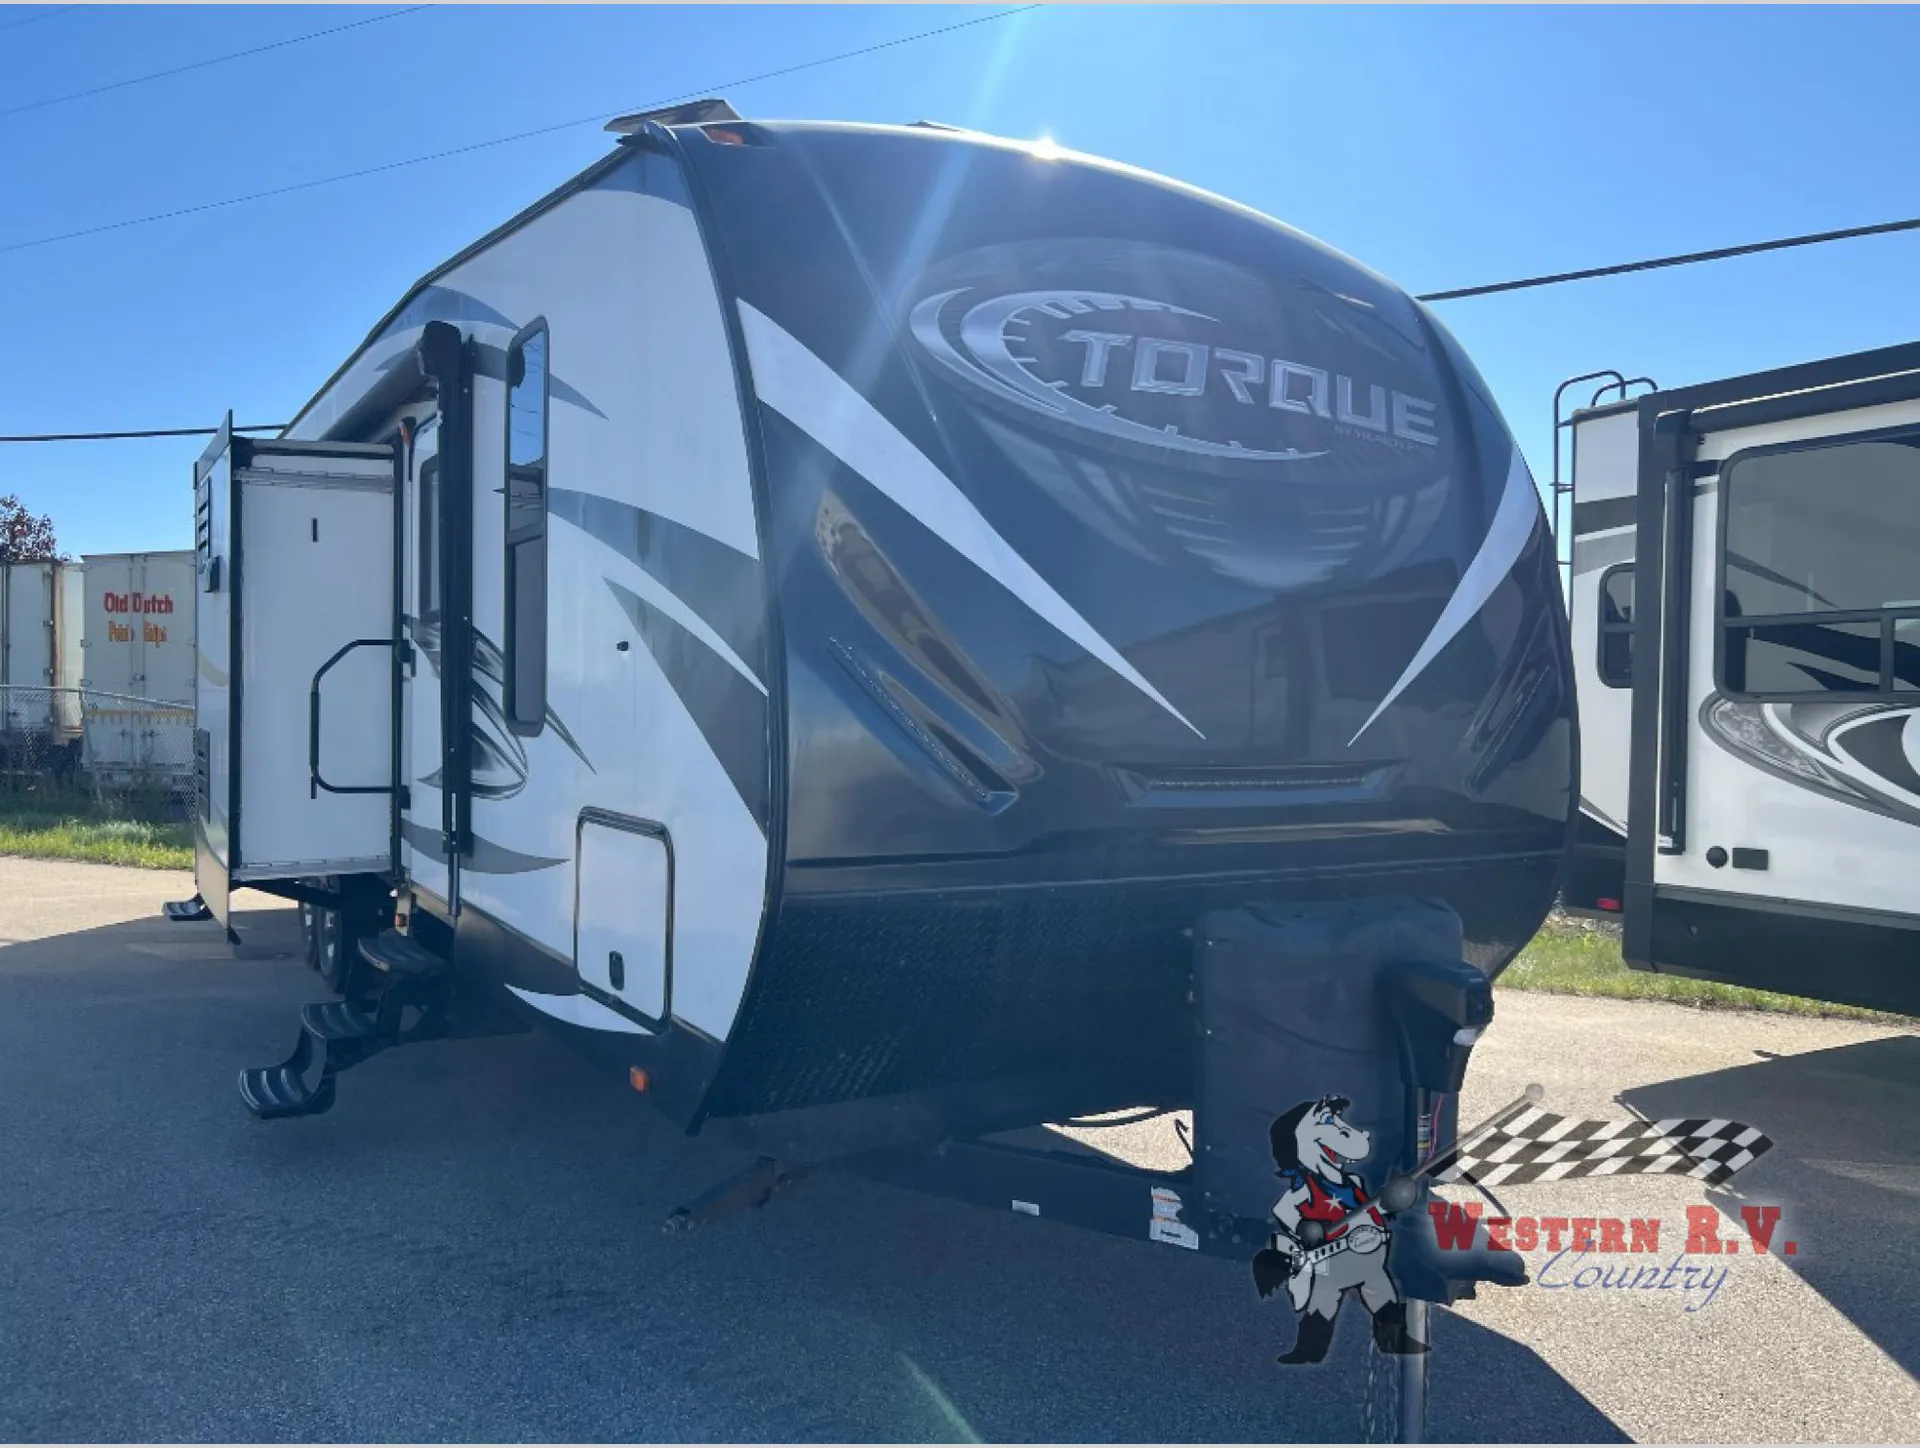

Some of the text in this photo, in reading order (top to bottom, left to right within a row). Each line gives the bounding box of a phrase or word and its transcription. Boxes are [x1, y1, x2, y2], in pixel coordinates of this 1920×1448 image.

[1057, 329, 1440, 446] TORQUE
[104, 592, 173, 613] Old Dutch
